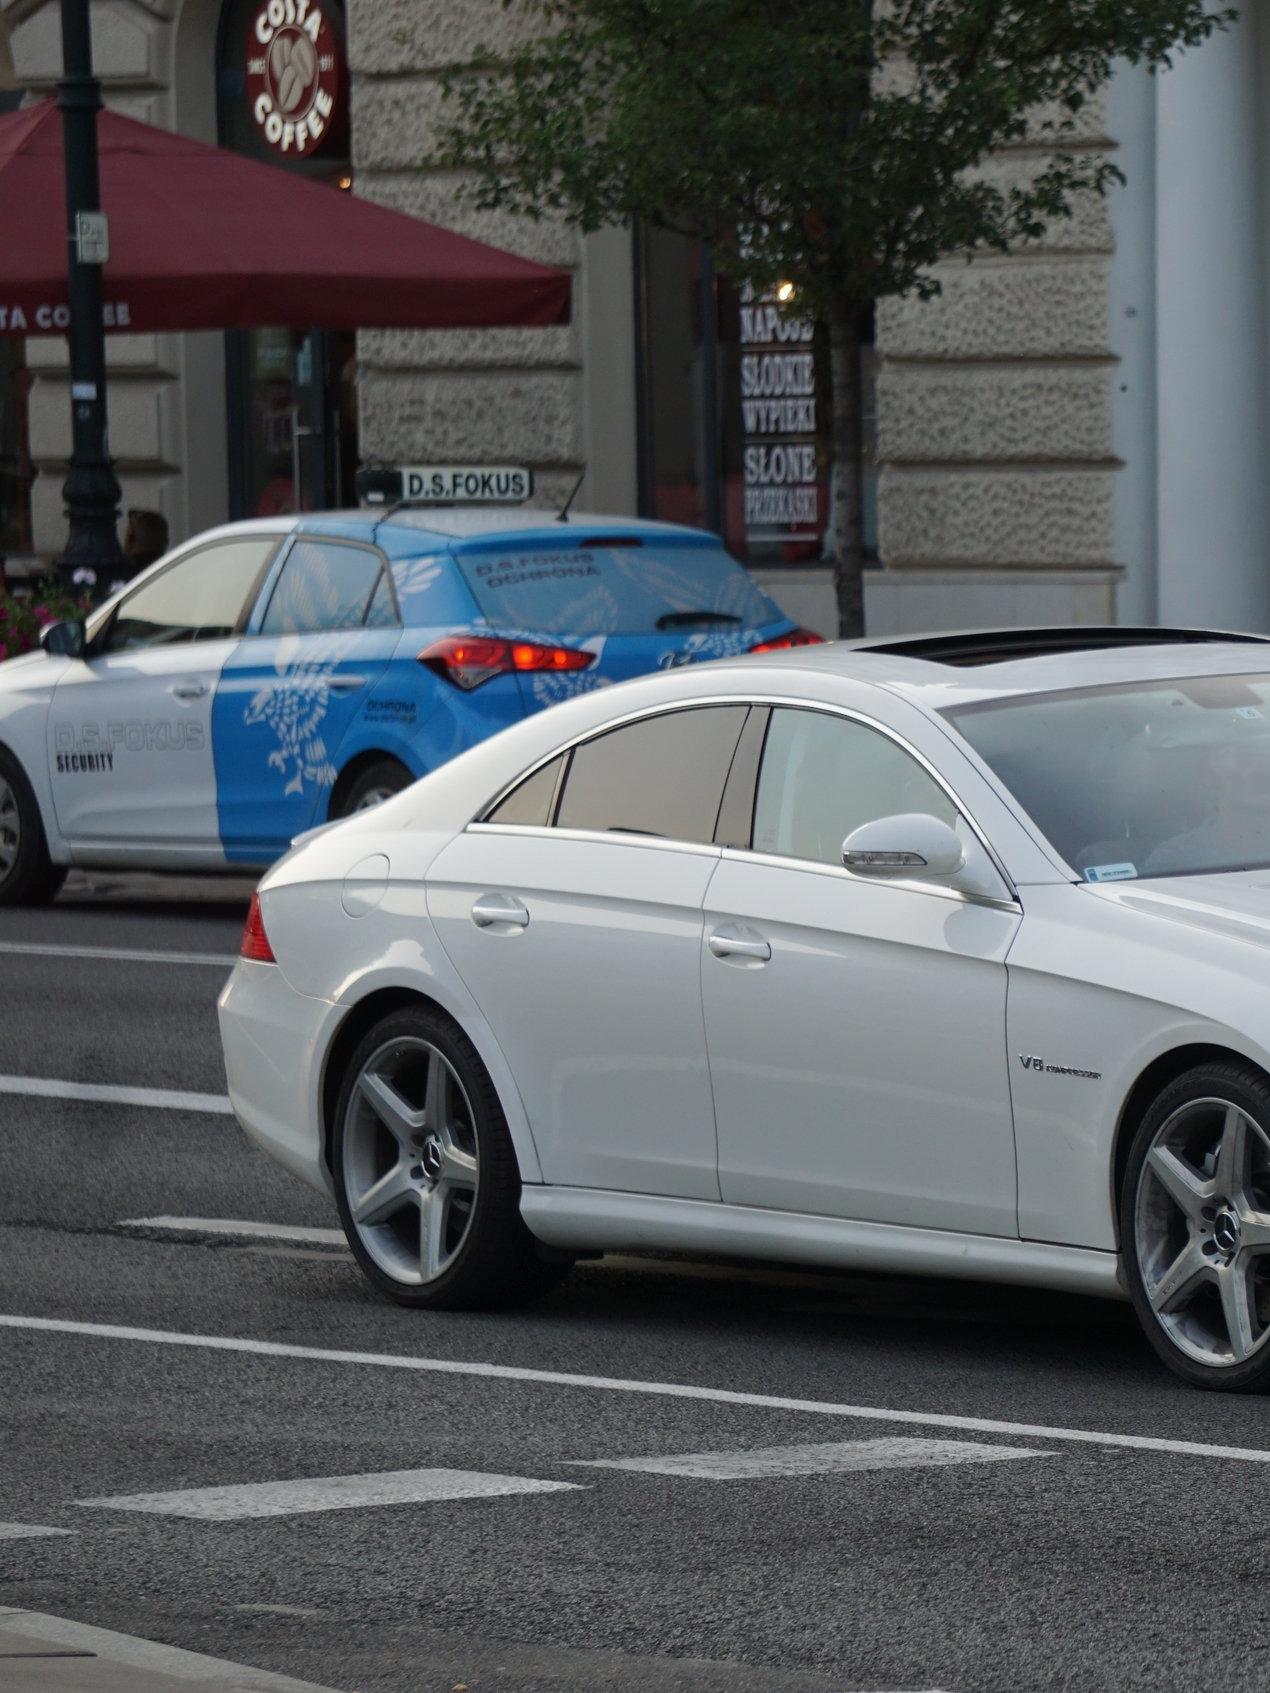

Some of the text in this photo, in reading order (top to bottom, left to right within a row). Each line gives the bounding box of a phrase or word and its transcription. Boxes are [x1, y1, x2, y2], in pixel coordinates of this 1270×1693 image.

[255, 0, 322, 44] COSTA
[254, 88, 333, 152] COFFEE
[35, 301, 131, 329] COEE
[742, 397, 817, 433] WYPIEKI
[744, 444, 817, 484] SŁONE
[409, 474, 524, 496] D.S.FOKUS
[55, 720, 205, 752] D.S.FOKUS
[56, 752, 114, 774] SECURITY
[1018, 1053, 1043, 1071] V8
